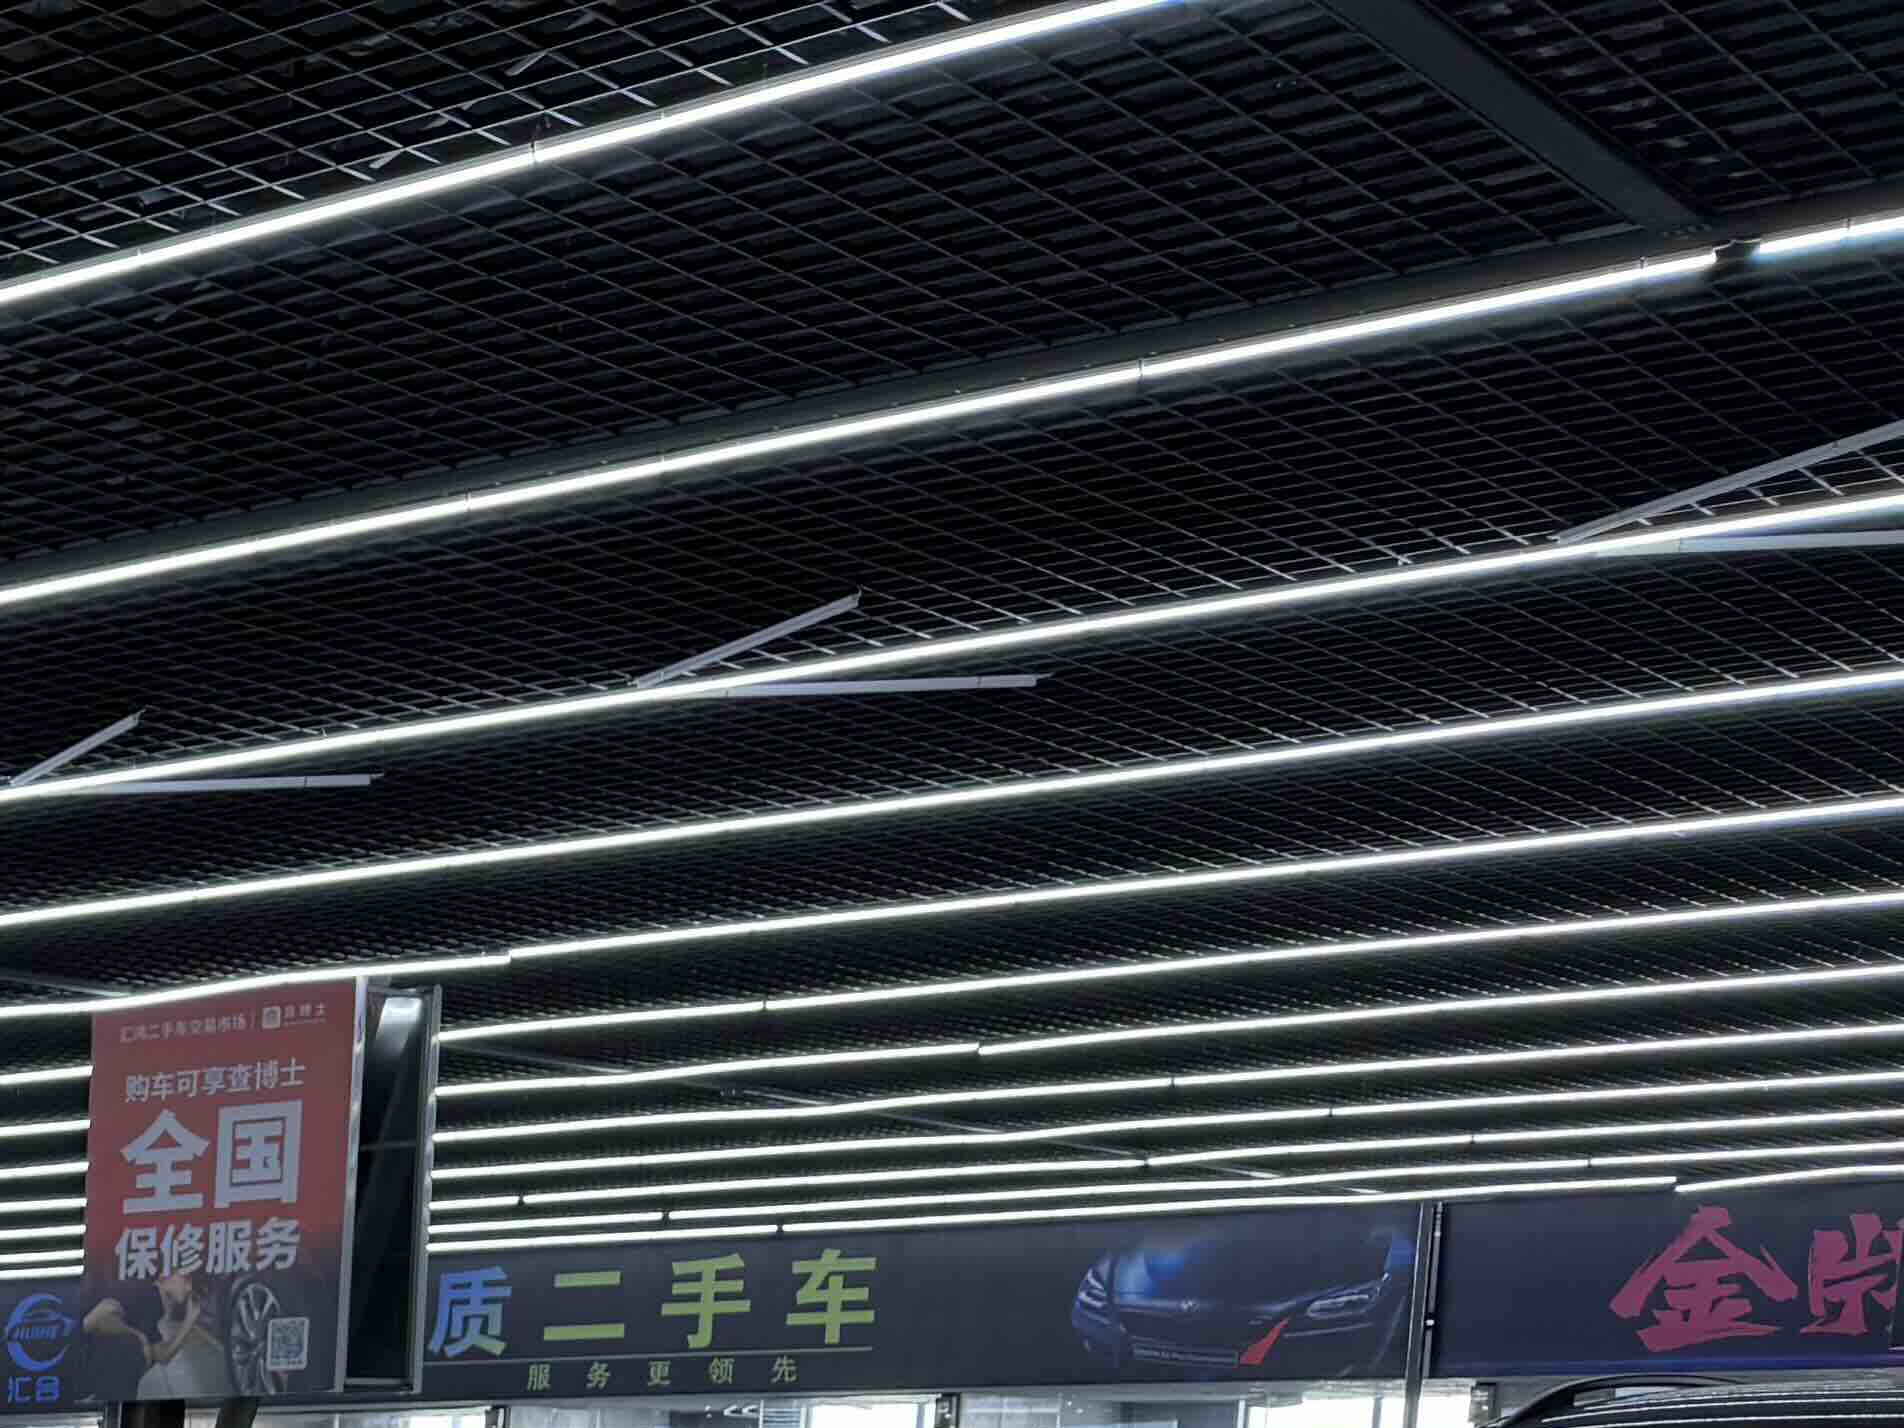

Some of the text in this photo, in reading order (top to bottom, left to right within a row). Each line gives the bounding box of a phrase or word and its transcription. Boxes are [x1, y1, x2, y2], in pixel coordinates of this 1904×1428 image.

[125, 1057, 306, 1103] 购车可享查博士
[120, 1099, 303, 1215] 全国
[115, 1217, 301, 1281] 保修服务
[428, 1248, 877, 1358] 质二手车
[526, 1357, 799, 1391] 服务更领先
